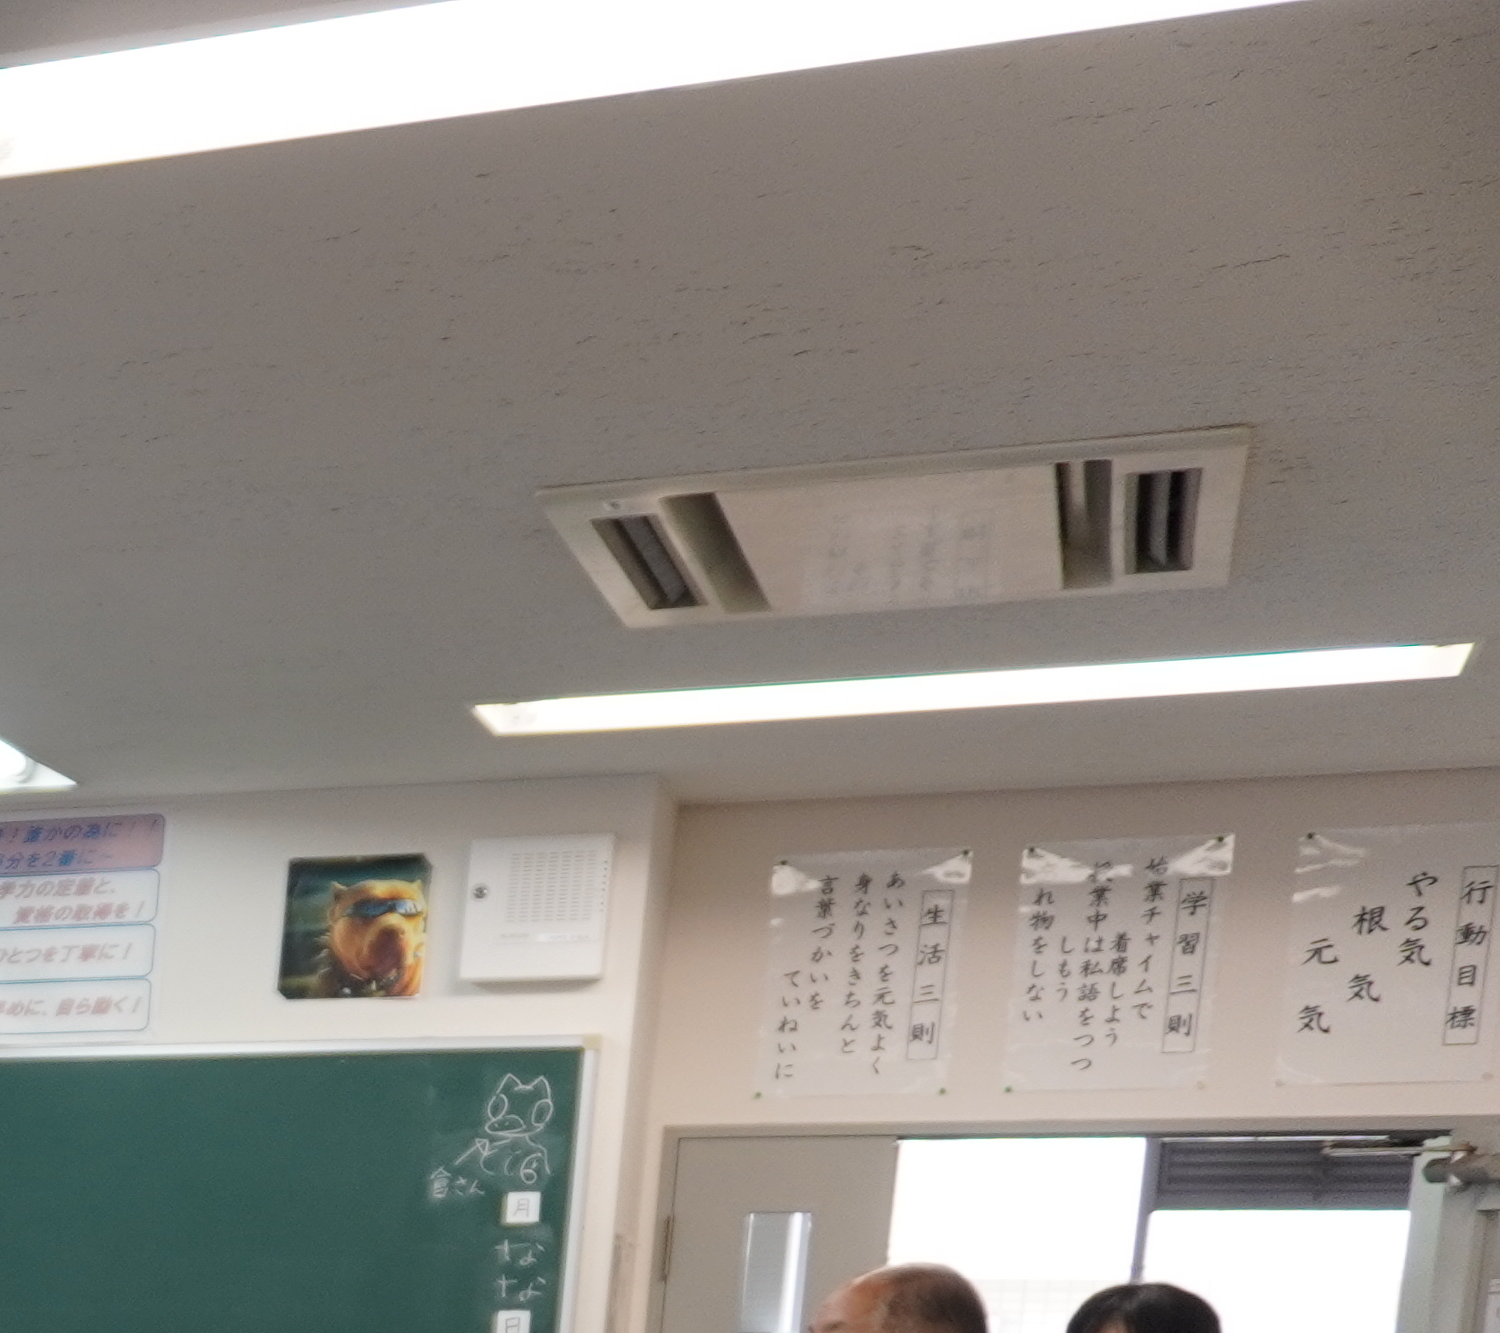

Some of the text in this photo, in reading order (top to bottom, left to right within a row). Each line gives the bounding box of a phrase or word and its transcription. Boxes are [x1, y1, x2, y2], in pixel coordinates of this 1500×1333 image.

[809, 875, 840, 1011] 言葉づかいを
[841, 872, 873, 1054] 身なりをきちんと
[870, 871, 906, 1075] あいさつを元気よく
[911, 904, 949, 1044] 生活三則
[1056, 936, 1074, 1002] しもう
[1105, 932, 1130, 1046] 着席しよう
[1132, 856, 1168, 1020] 始業チャイムで
[1167, 891, 1209, 1036] 学習三則
[1397, 872, 1438, 967] やる気
[1445, 881, 1493, 1029] 行動目標
[775, 970, 800, 1080] ていねいに
